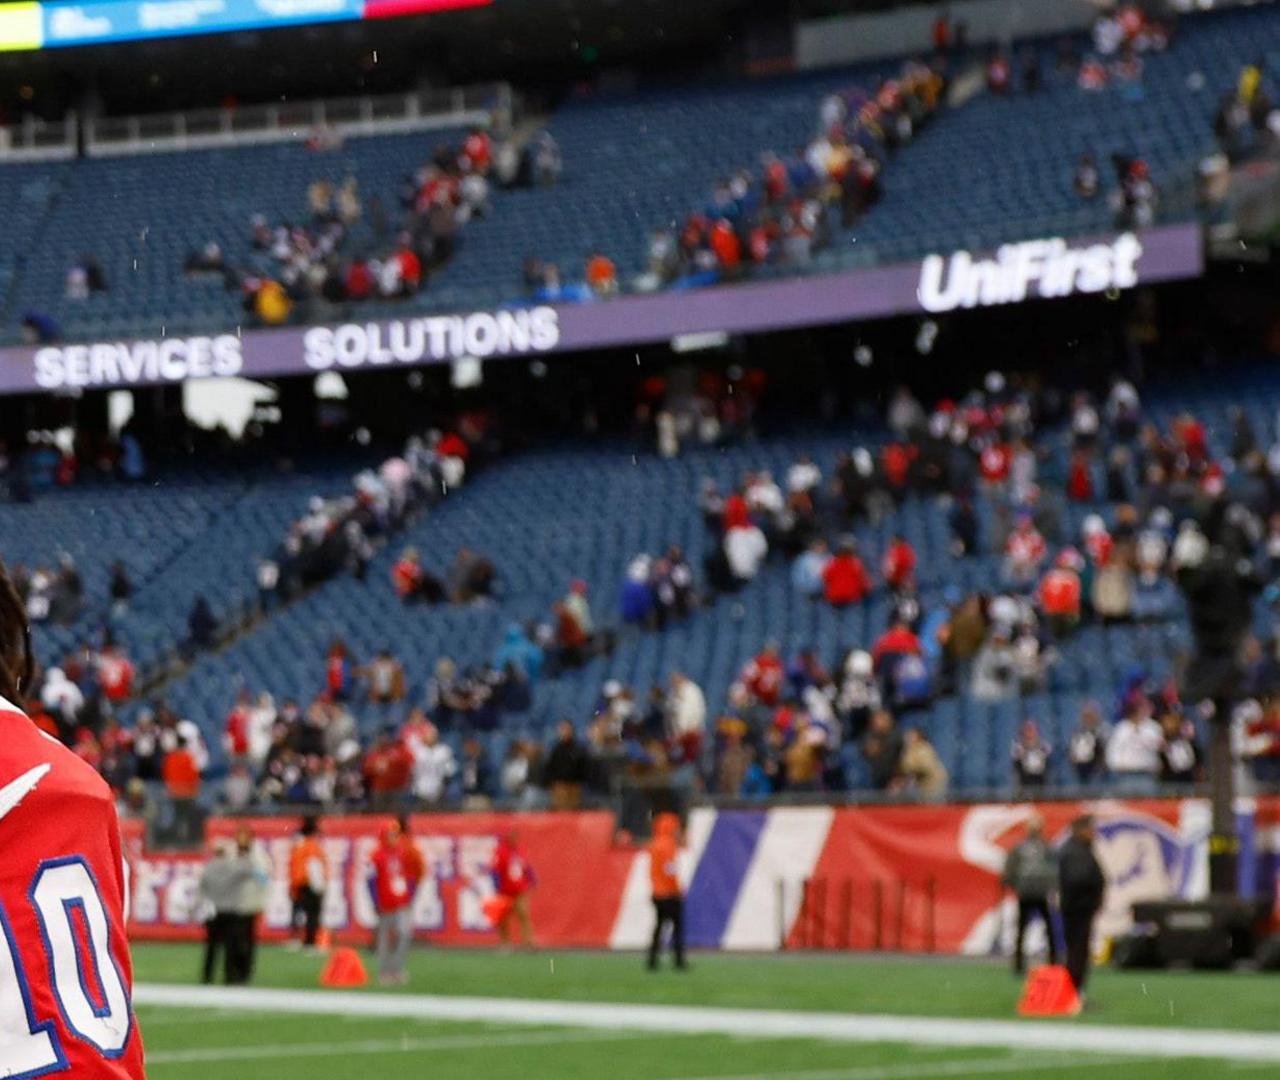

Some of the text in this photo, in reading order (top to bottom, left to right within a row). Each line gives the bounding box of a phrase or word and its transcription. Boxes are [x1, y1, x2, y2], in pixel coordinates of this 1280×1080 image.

[917, 232, 1142, 313] UniFirst
[34, 335, 241, 387] SERVICES
[303, 306, 559, 370] SOLUTIONS
